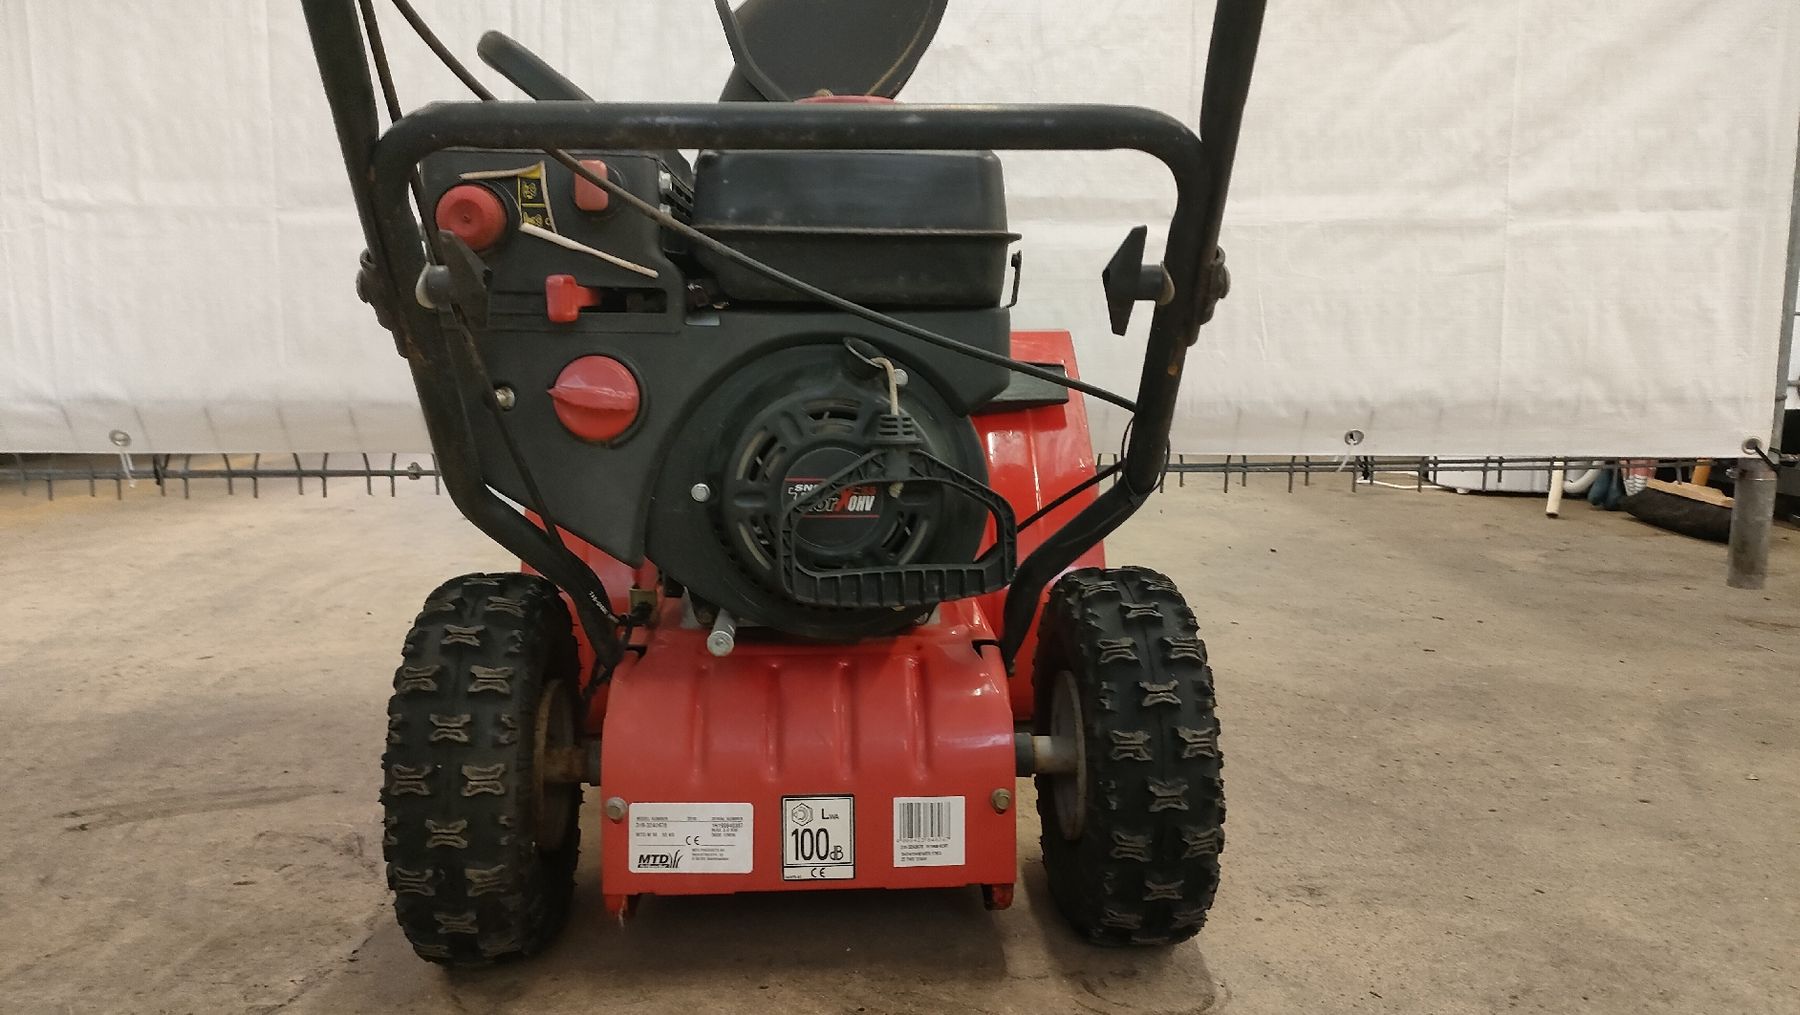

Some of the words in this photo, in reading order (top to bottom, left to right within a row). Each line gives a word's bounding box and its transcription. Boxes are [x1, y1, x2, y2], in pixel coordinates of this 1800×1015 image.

[847, 495, 876, 512] OHV
[685, 835, 700, 846] CE
[791, 828, 829, 861] 100
[829, 845, 844, 861] dB
[638, 854, 669, 864] MTD
[810, 867, 826, 878] CE
